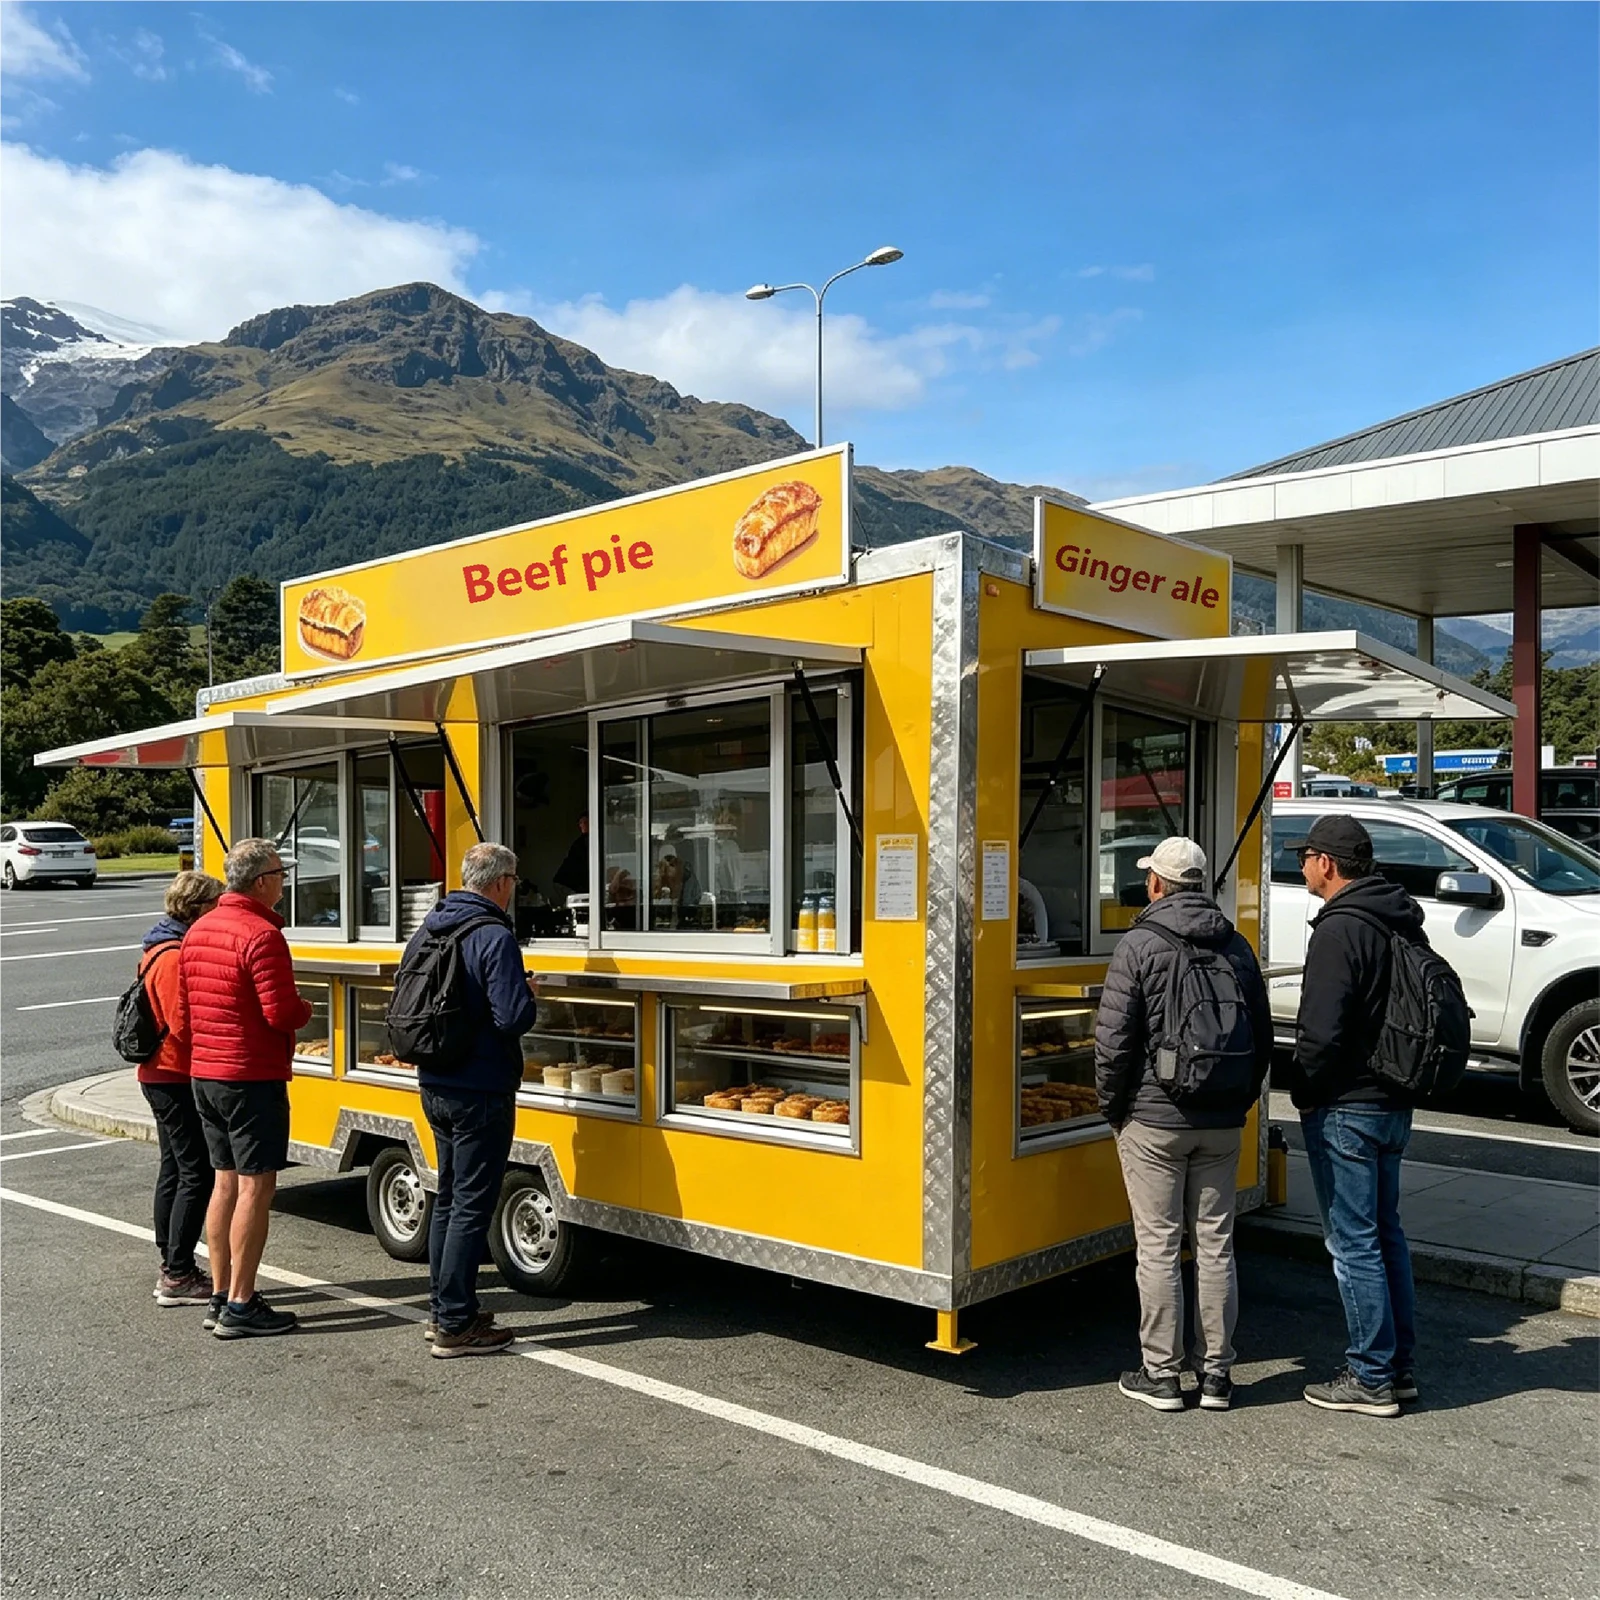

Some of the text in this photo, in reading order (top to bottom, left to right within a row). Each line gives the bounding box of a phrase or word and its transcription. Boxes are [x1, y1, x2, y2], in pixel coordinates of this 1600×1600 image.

[463, 534, 653, 603] Beef pie
[1055, 544, 1220, 609] Ginger ale
